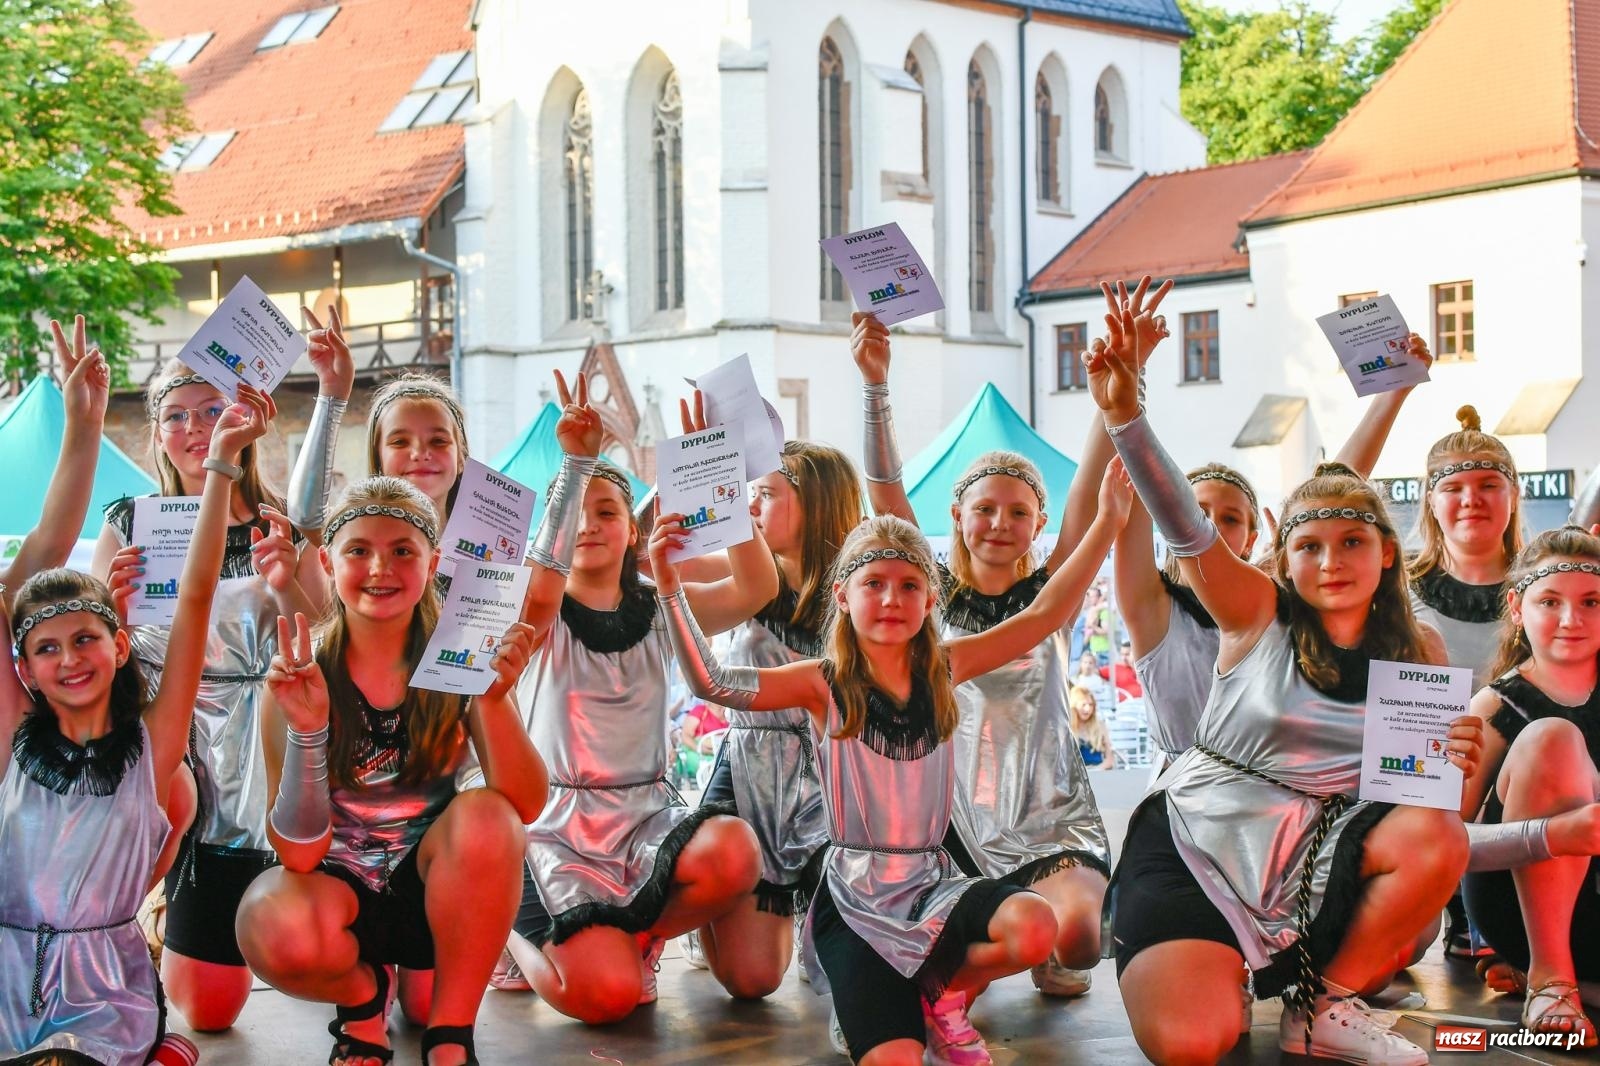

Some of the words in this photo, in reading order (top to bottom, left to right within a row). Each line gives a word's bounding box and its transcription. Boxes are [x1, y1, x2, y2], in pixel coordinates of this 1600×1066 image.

[844, 230, 884, 244] DYPLOM
[1340, 302, 1378, 319] DYPLOM
[260, 300, 293, 338] DYPLOM
[681, 431, 725, 449] DYPLOM
[486, 473, 521, 497] DYPLOM
[1392, 480, 1420, 502] GR
[1518, 473, 1566, 496] YTKI
[477, 568, 514, 581] DYPLOM
[145, 579, 179, 595] md
[1399, 671, 1450, 684] DYPLOM
[1380, 698, 1413, 707] ZUZANNA
